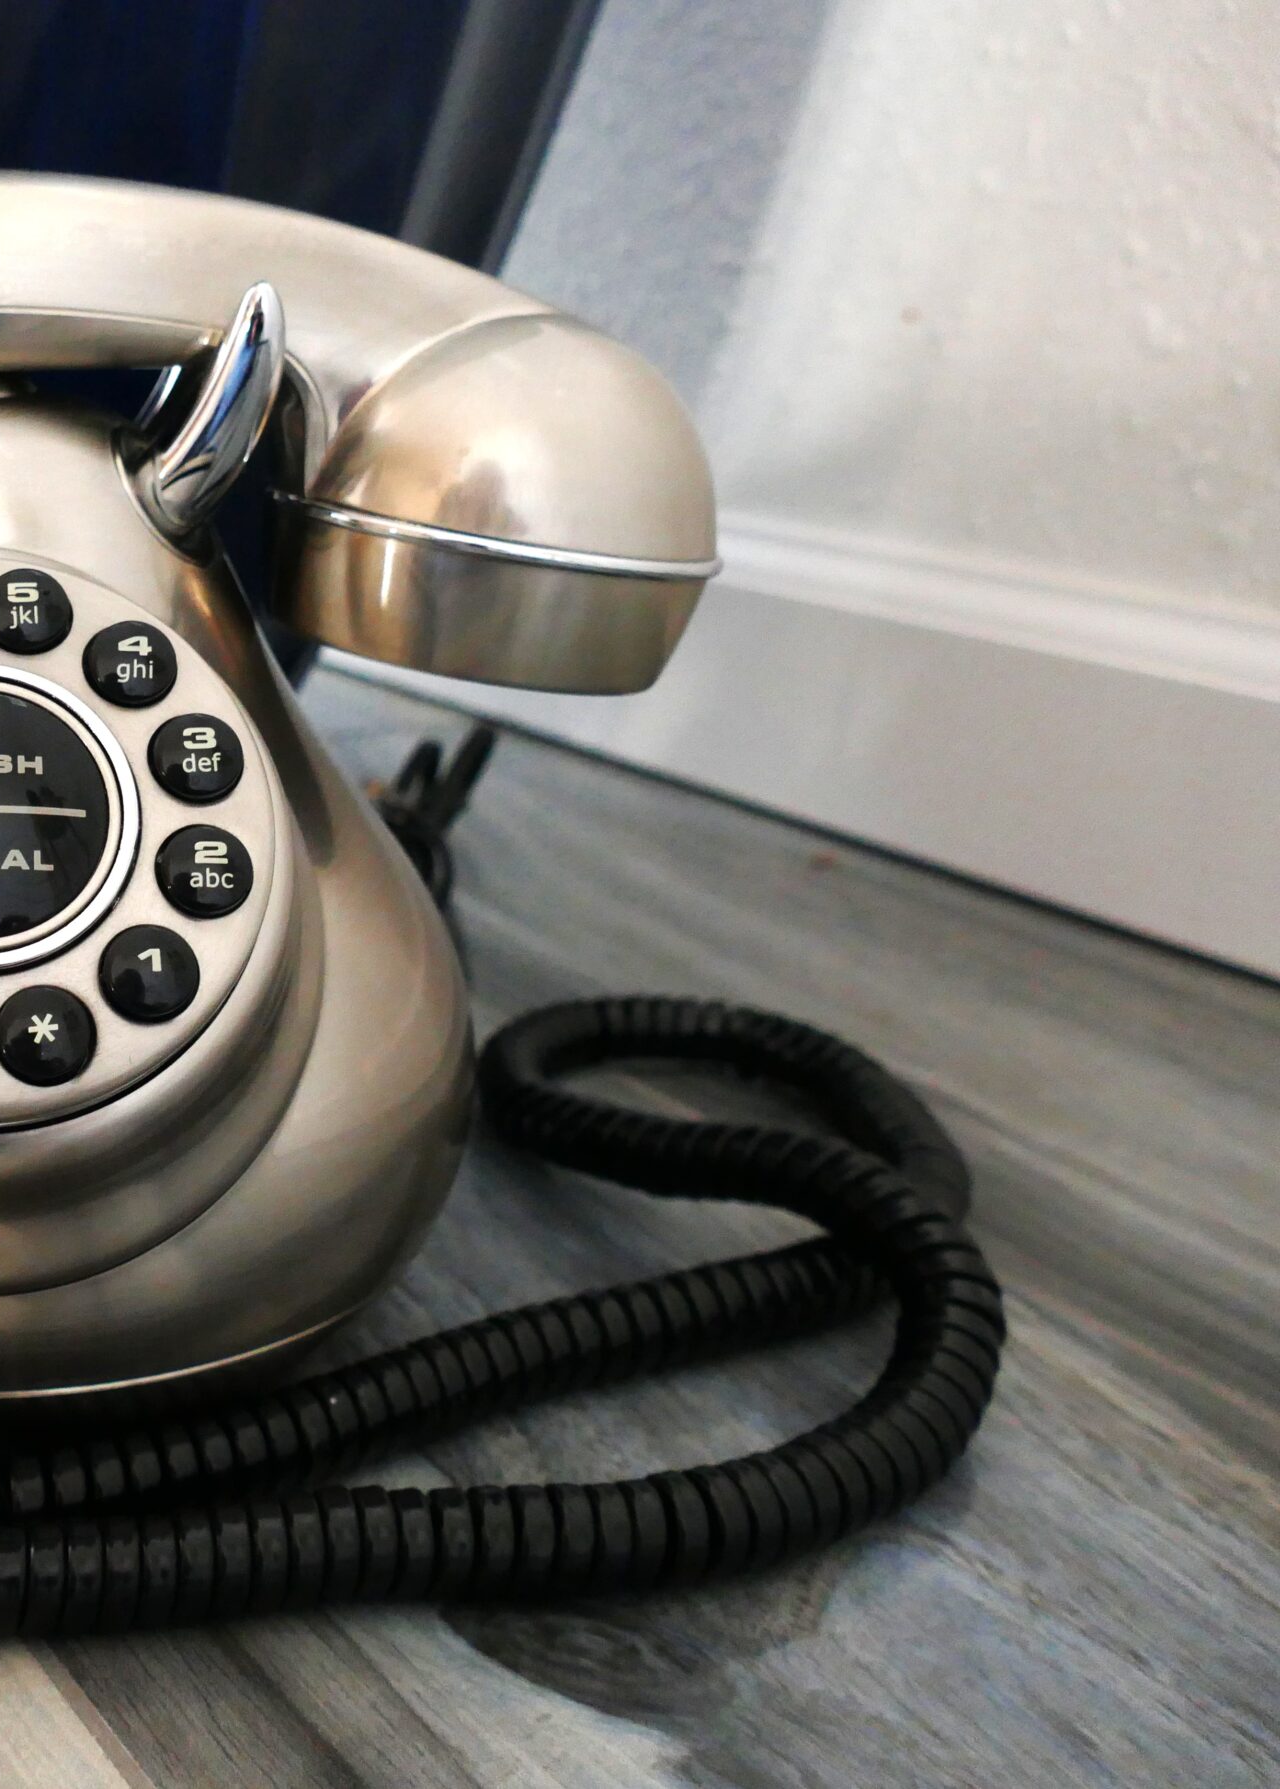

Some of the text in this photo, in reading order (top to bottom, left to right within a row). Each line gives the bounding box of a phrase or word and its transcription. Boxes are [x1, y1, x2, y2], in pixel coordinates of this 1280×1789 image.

[7, 582, 39, 602] 5
[10, 605, 39, 629] jkl
[118, 636, 152, 656] 4
[116, 659, 154, 683] ghi
[183, 727, 217, 749] 3
[182, 752, 221, 773] def
[194, 841, 228, 864] 2
[189, 868, 234, 889] abc
[138, 948, 162, 972] 1
